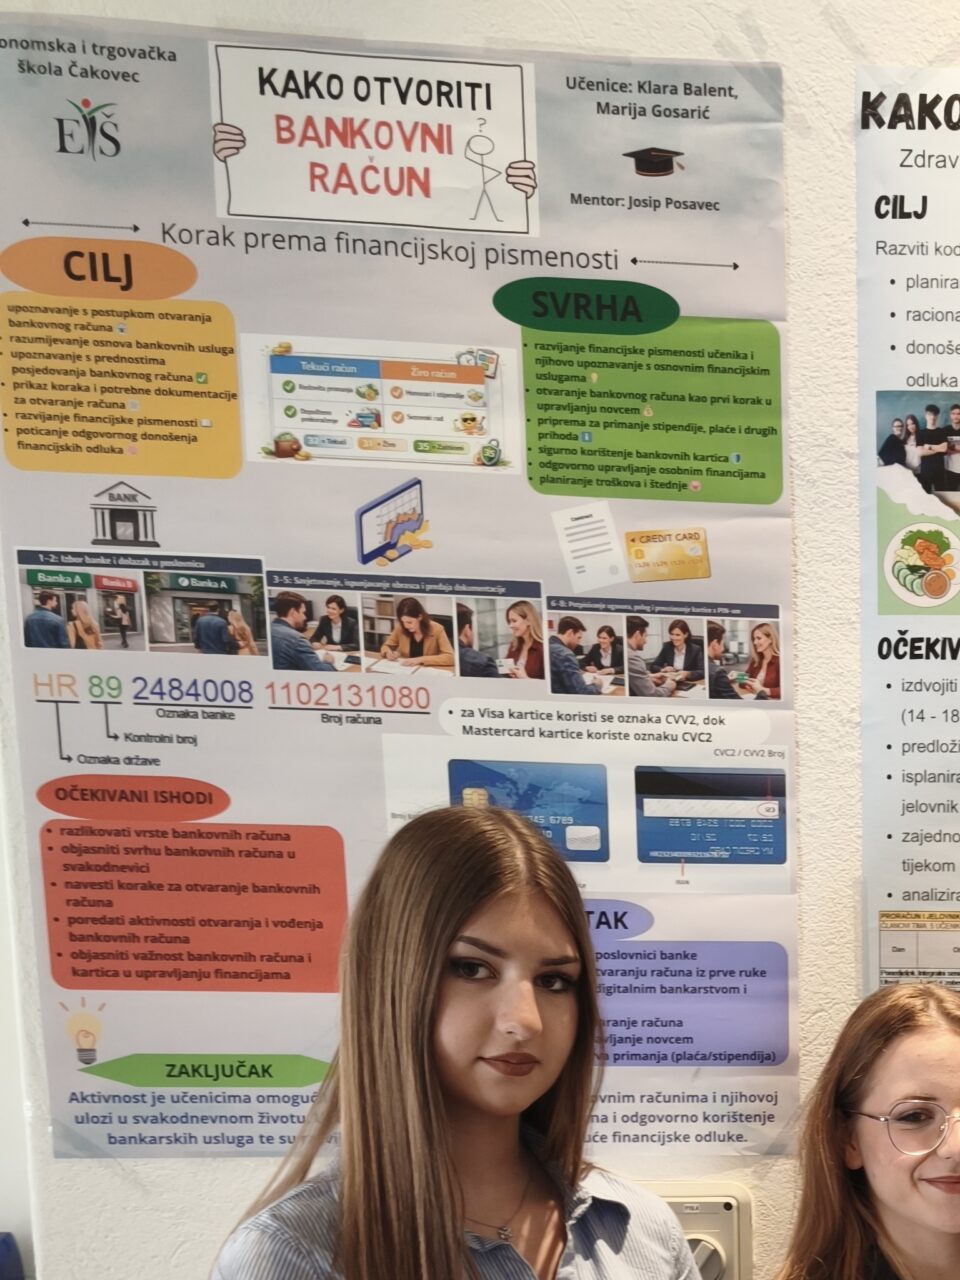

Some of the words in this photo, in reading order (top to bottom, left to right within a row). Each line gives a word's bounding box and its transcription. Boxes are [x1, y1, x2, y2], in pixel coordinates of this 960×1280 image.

[0, 38, 77, 54] onomska
[82, 39, 86, 54] i
[91, 42, 177, 62] trgovačka
[17, 59, 63, 76] škola
[68, 60, 140, 83] Čakovec
[258, 66, 344, 100] KAKO
[353, 75, 492, 111] OTVORITI
[566, 76, 632, 93] Učenice:
[637, 80, 678, 95] Klara
[683, 82, 738, 100] Balent,
[596, 101, 647, 120] Marija
[651, 103, 710, 120] Gosarić
[274, 113, 453, 155] BANKOVNI
[309, 156, 431, 198] RAČUN
[570, 192, 625, 207] Mentor:
[626, 195, 661, 212] Josip
[664, 197, 720, 211] Posavec
[874, 194, 928, 220] CILJ
[160, 223, 235, 248] Korak
[244, 231, 326, 254] prema
[334, 231, 475, 269] financijskoj
[484, 242, 618, 270] pismenosti
[875, 240, 928, 256] Razviti
[63, 250, 133, 291] CILJ
[7, 304, 80, 317] upoznavanje
[82, 308, 88, 316] s
[90, 308, 155, 320] postupkom
[157, 312, 212, 325] otvaranja
[532, 290, 643, 323] SVRHA
[906, 372, 958, 388] odluka
[14, 411, 70, 424] razvijanje
[72, 412, 134, 427] financijske
[136, 416, 198, 427] pismenosti
[639, 534, 672, 543] CREDIT
[675, 532, 701, 540] CARD
[37, 572, 72, 584] Banka
[72, 574, 83, 585] A
[190, 577, 217, 588] Banka
[218, 580, 229, 590] A
[32, 672, 80, 698] HR
[88, 674, 122, 700] 89
[132, 676, 254, 704] 2484008
[266, 683, 430, 709] 1102131080
[901, 678, 957, 696] izdvojiti
[460, 709, 475, 718] za
[477, 707, 504, 719] Visa
[508, 708, 553, 721] kartice
[556, 710, 597, 722] koristi
[600, 714, 614, 723] se
[617, 713, 662, 724] oznaka
[665, 714, 699, 726] CVV2,
[702, 715, 725, 726] dok
[462, 725, 535, 737] Mastercard
[538, 727, 583, 739] kartice
[586, 729, 630, 741] koriste
[633, 731, 678, 742] oznaku
[681, 731, 712, 743] CVC2
[54, 784, 149, 803] OČEKIVANI
[153, 790, 213, 805] ISHODI
[612, 1050, 668, 1064] primanja
[670, 1050, 776, 1064] (plaća/stipendija)
[165, 1060, 273, 1081] ZAKLJUČAK
[68, 1091, 147, 1104] Aktivnost
[150, 1091, 166, 1107] je
[170, 1091, 252, 1104] učenicima
[74, 1112, 112, 1124] ulozi
[117, 1115, 128, 1124] u
[132, 1111, 254, 1125] svakodnevnom
[611, 1130, 690, 1146] financijske
[694, 1130, 748, 1142] odluke.
